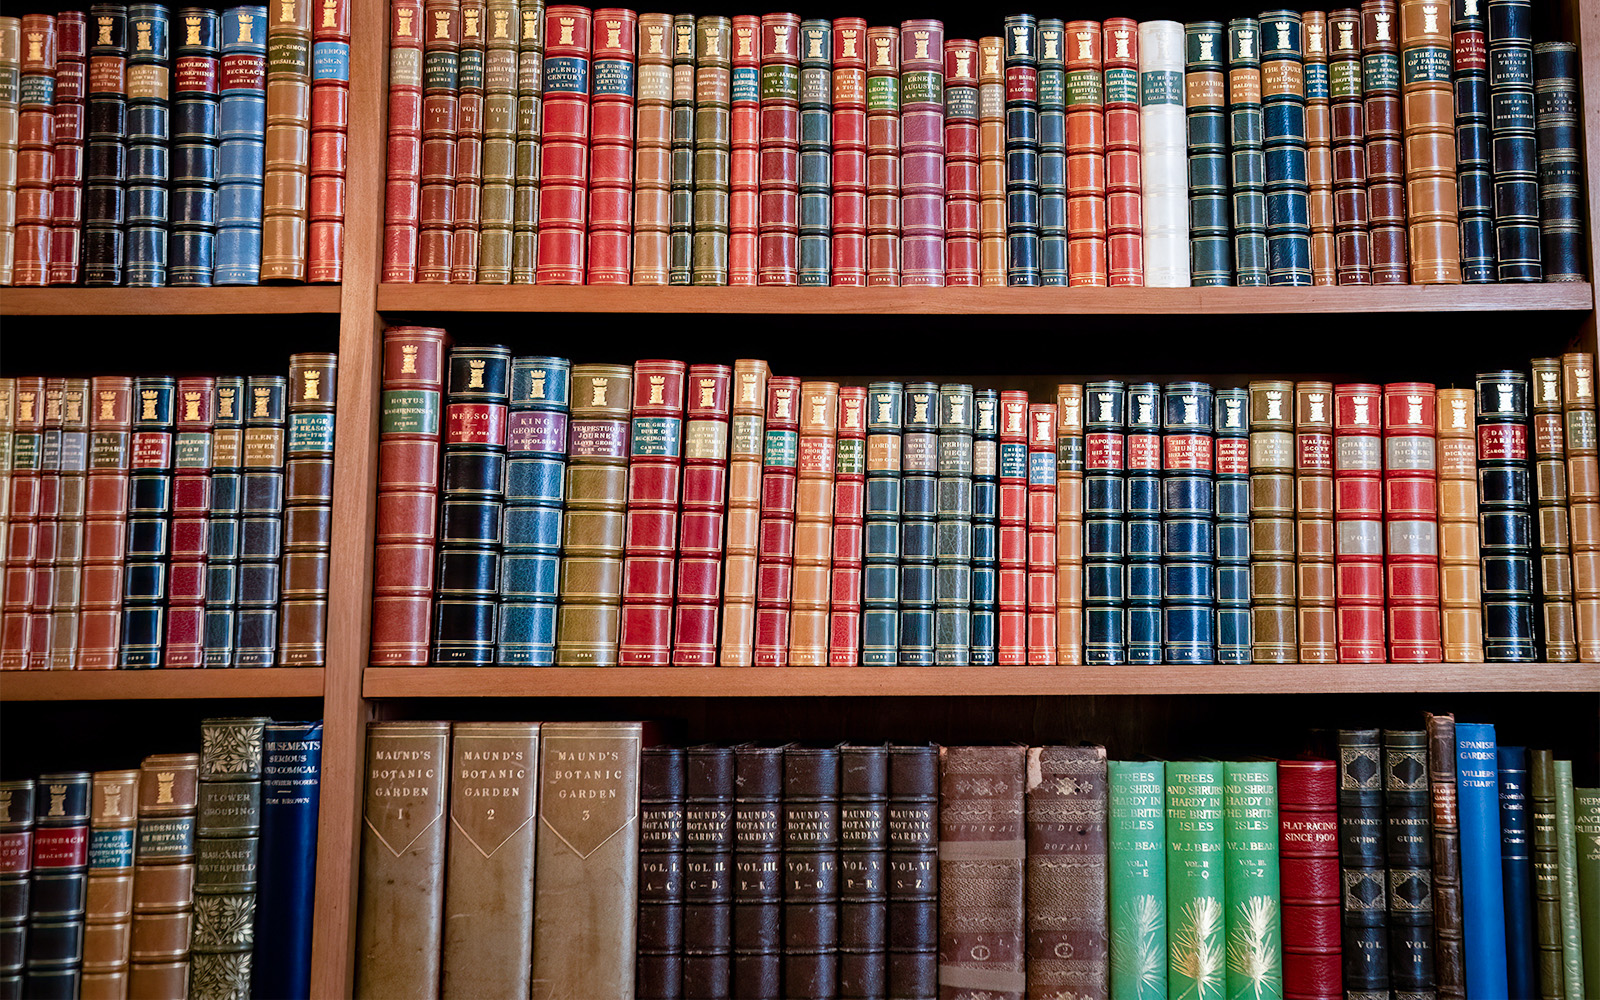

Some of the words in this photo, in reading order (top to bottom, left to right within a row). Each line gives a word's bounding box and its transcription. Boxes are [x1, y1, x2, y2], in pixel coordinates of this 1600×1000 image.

[376, 751, 430, 760] MAUND'S
[464, 751, 523, 761] MAUND'S
[558, 752, 618, 760] MAUND'S
[372, 770, 434, 779] BOTANIC
[462, 770, 525, 779] BOTANIC
[555, 770, 622, 779] BOTANIC
[1117, 773, 1154, 782] TREES
[1176, 774, 1214, 782] TREES
[1231, 773, 1269, 782] TREES
[375, 788, 429, 797] GARDEN
[465, 788, 519, 797] GARDEN
[559, 789, 616, 798] GARDEN
[1168, 786, 1186, 794] AND
[1188, 786, 1223, 794] SHRUBS
[1112, 797, 1147, 805] HARDY
[1172, 799, 1205, 807] HARDY
[1210, 799, 1220, 807] IN
[1226, 797, 1262, 805] HARDY
[203, 808, 255, 816] GROUPING
[487, 809, 494, 820] 2
[582, 810, 590, 821] 3
[643, 811, 682, 820] MAUND'S
[687, 811, 726, 820] MAUND'S
[737, 811, 775, 820] MAUND'S
[789, 811, 829, 819] MAUND'S
[842, 810, 879, 818] MAUND'S
[890, 810, 929, 818] MAUND'S
[1168, 810, 1186, 818] THE
[642, 821, 682, 830] BOTANIC
[686, 822, 726, 830] BOTANIC
[736, 821, 777, 830] BOTANIC
[788, 821, 830, 830] BOTANIC
[842, 821, 881, 829] BOTANIC
[890, 821, 930, 829] BOTANIC
[1180, 822, 1214, 831] ISLES
[1235, 821, 1269, 830] ISLES
[1283, 822, 1336, 830] FLAT-RACING
[688, 833, 723, 841] GARDEN
[738, 832, 774, 841] GARDEN
[891, 832, 929, 840] GARDEN
[1285, 833, 1313, 842] SINCE
[1315, 833, 1335, 842] 1900
[1195, 843, 1221, 851] BEAN
[202, 850, 251, 859] MARGARET
[822, 862, 833, 871] IV.
